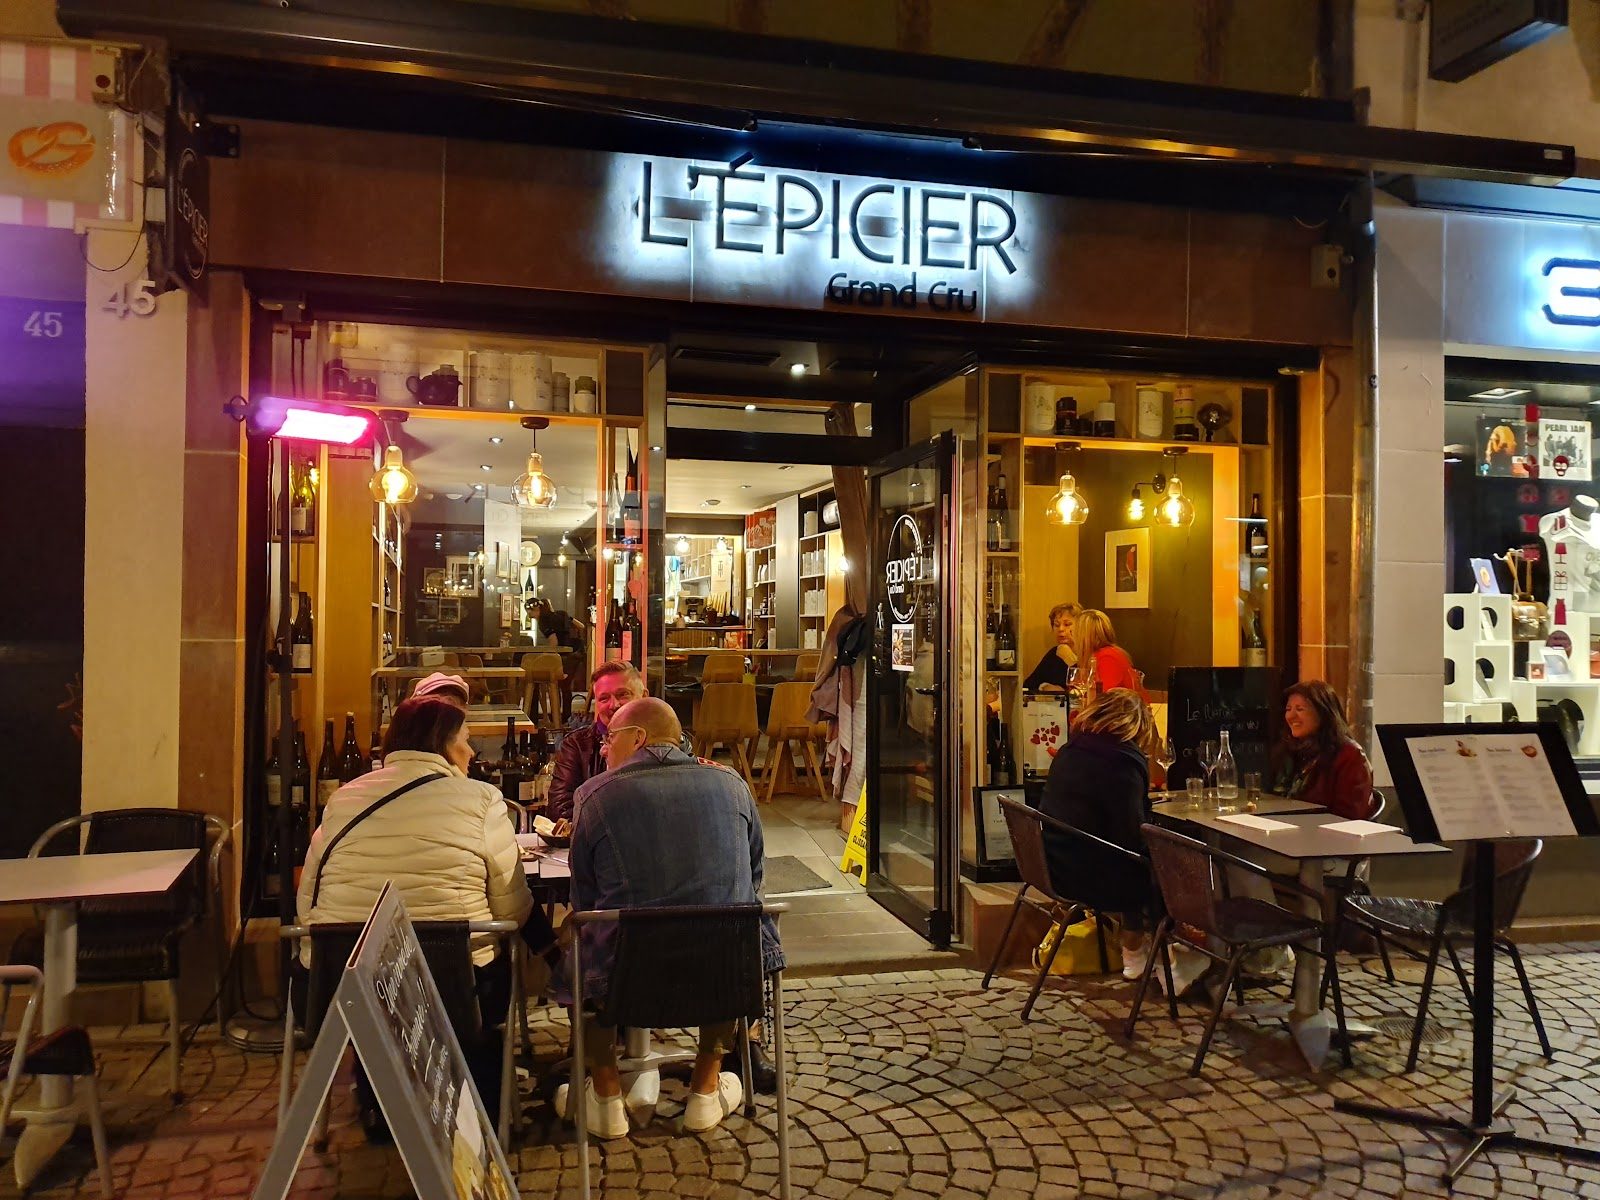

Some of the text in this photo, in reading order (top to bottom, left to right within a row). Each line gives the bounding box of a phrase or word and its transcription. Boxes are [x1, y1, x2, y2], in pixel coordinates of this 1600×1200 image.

[640, 152, 1018, 275] L'ÉPICIER
[102, 280, 156, 320] 45
[827, 272, 978, 313] Grand Cru
[23, 311, 64, 338] 45
